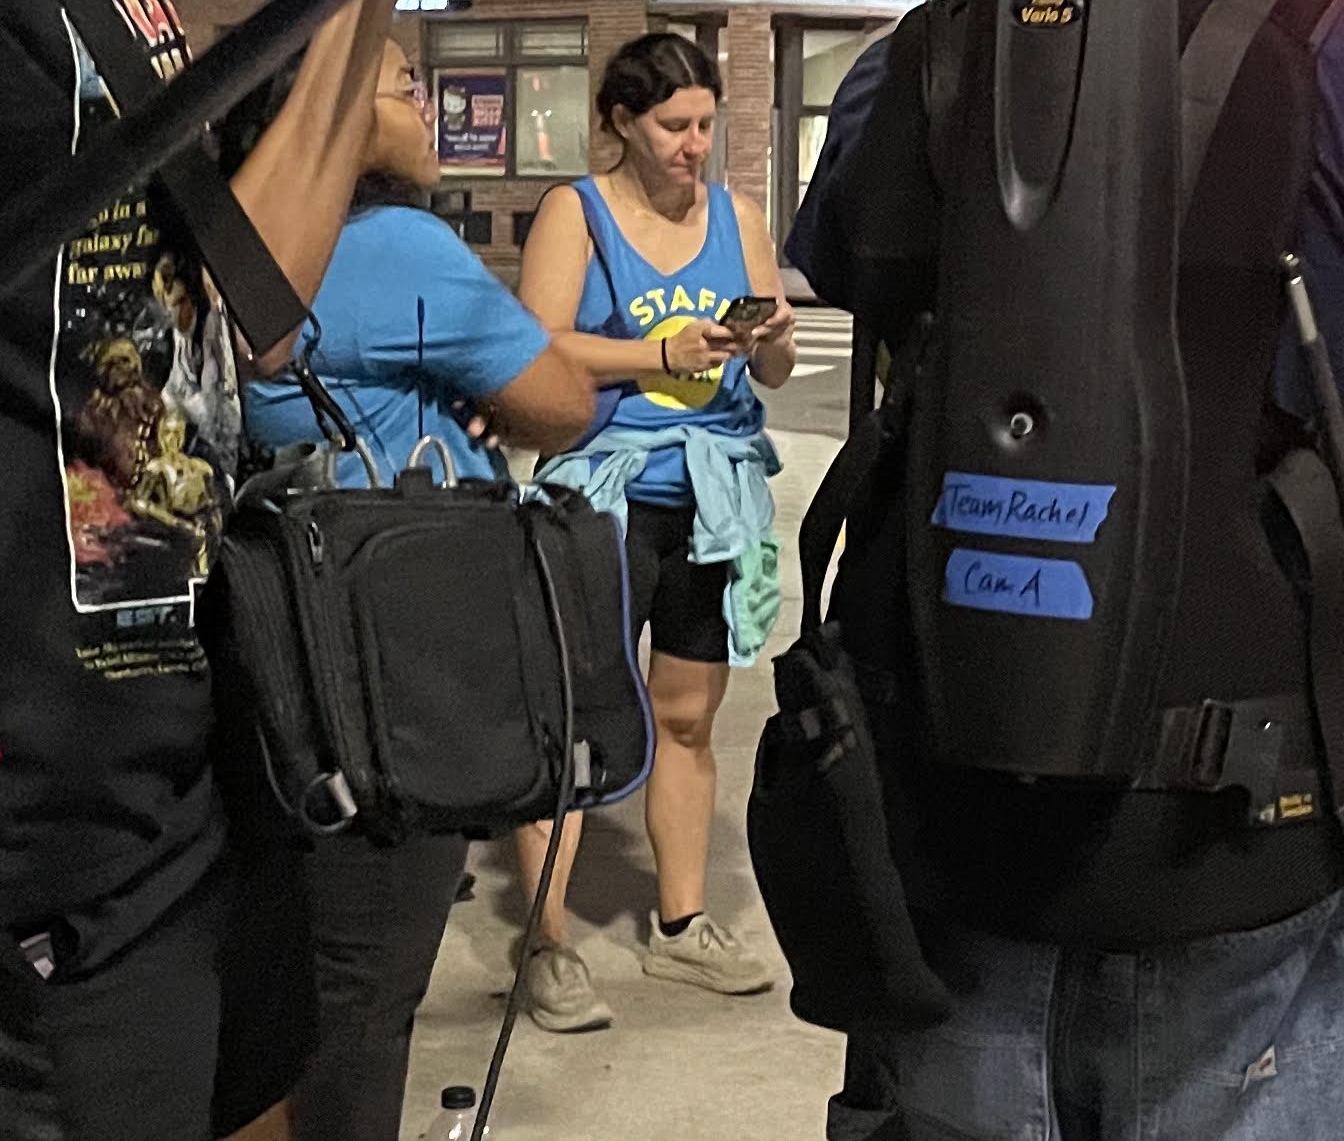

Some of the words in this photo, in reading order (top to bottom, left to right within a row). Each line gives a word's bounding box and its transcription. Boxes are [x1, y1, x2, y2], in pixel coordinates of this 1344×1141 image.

[1003, 490, 1089, 528] Rachel
[964, 561, 1015, 595] Cam
[1019, 567, 1041, 606] A
